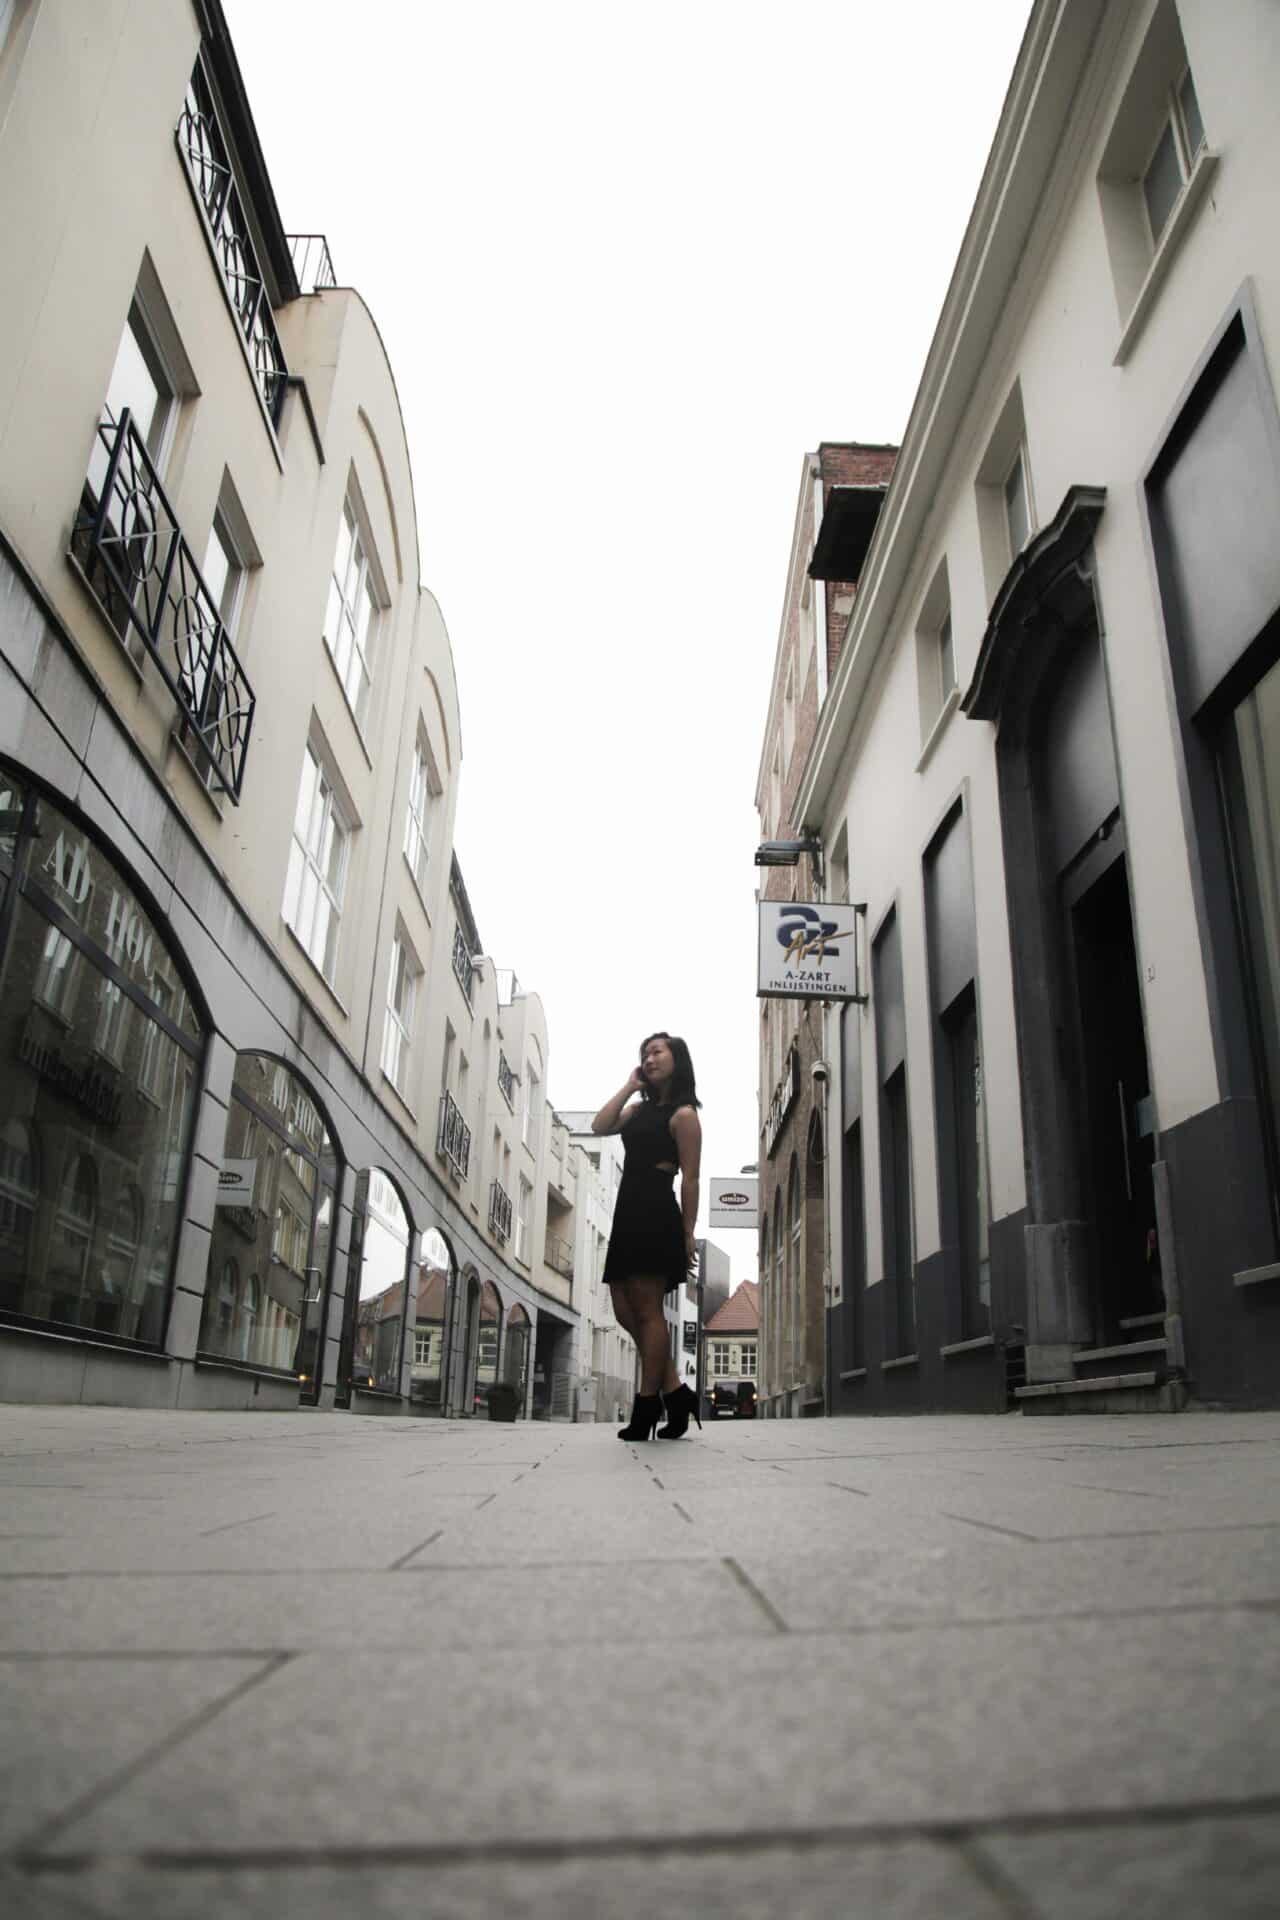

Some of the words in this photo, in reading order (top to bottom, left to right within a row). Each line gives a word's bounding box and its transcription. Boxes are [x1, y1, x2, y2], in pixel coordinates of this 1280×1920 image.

[42, 830, 91, 904] AD
[785, 971, 831, 982] A-ZART
[770, 981, 846, 992] INLIJSTINGEN
